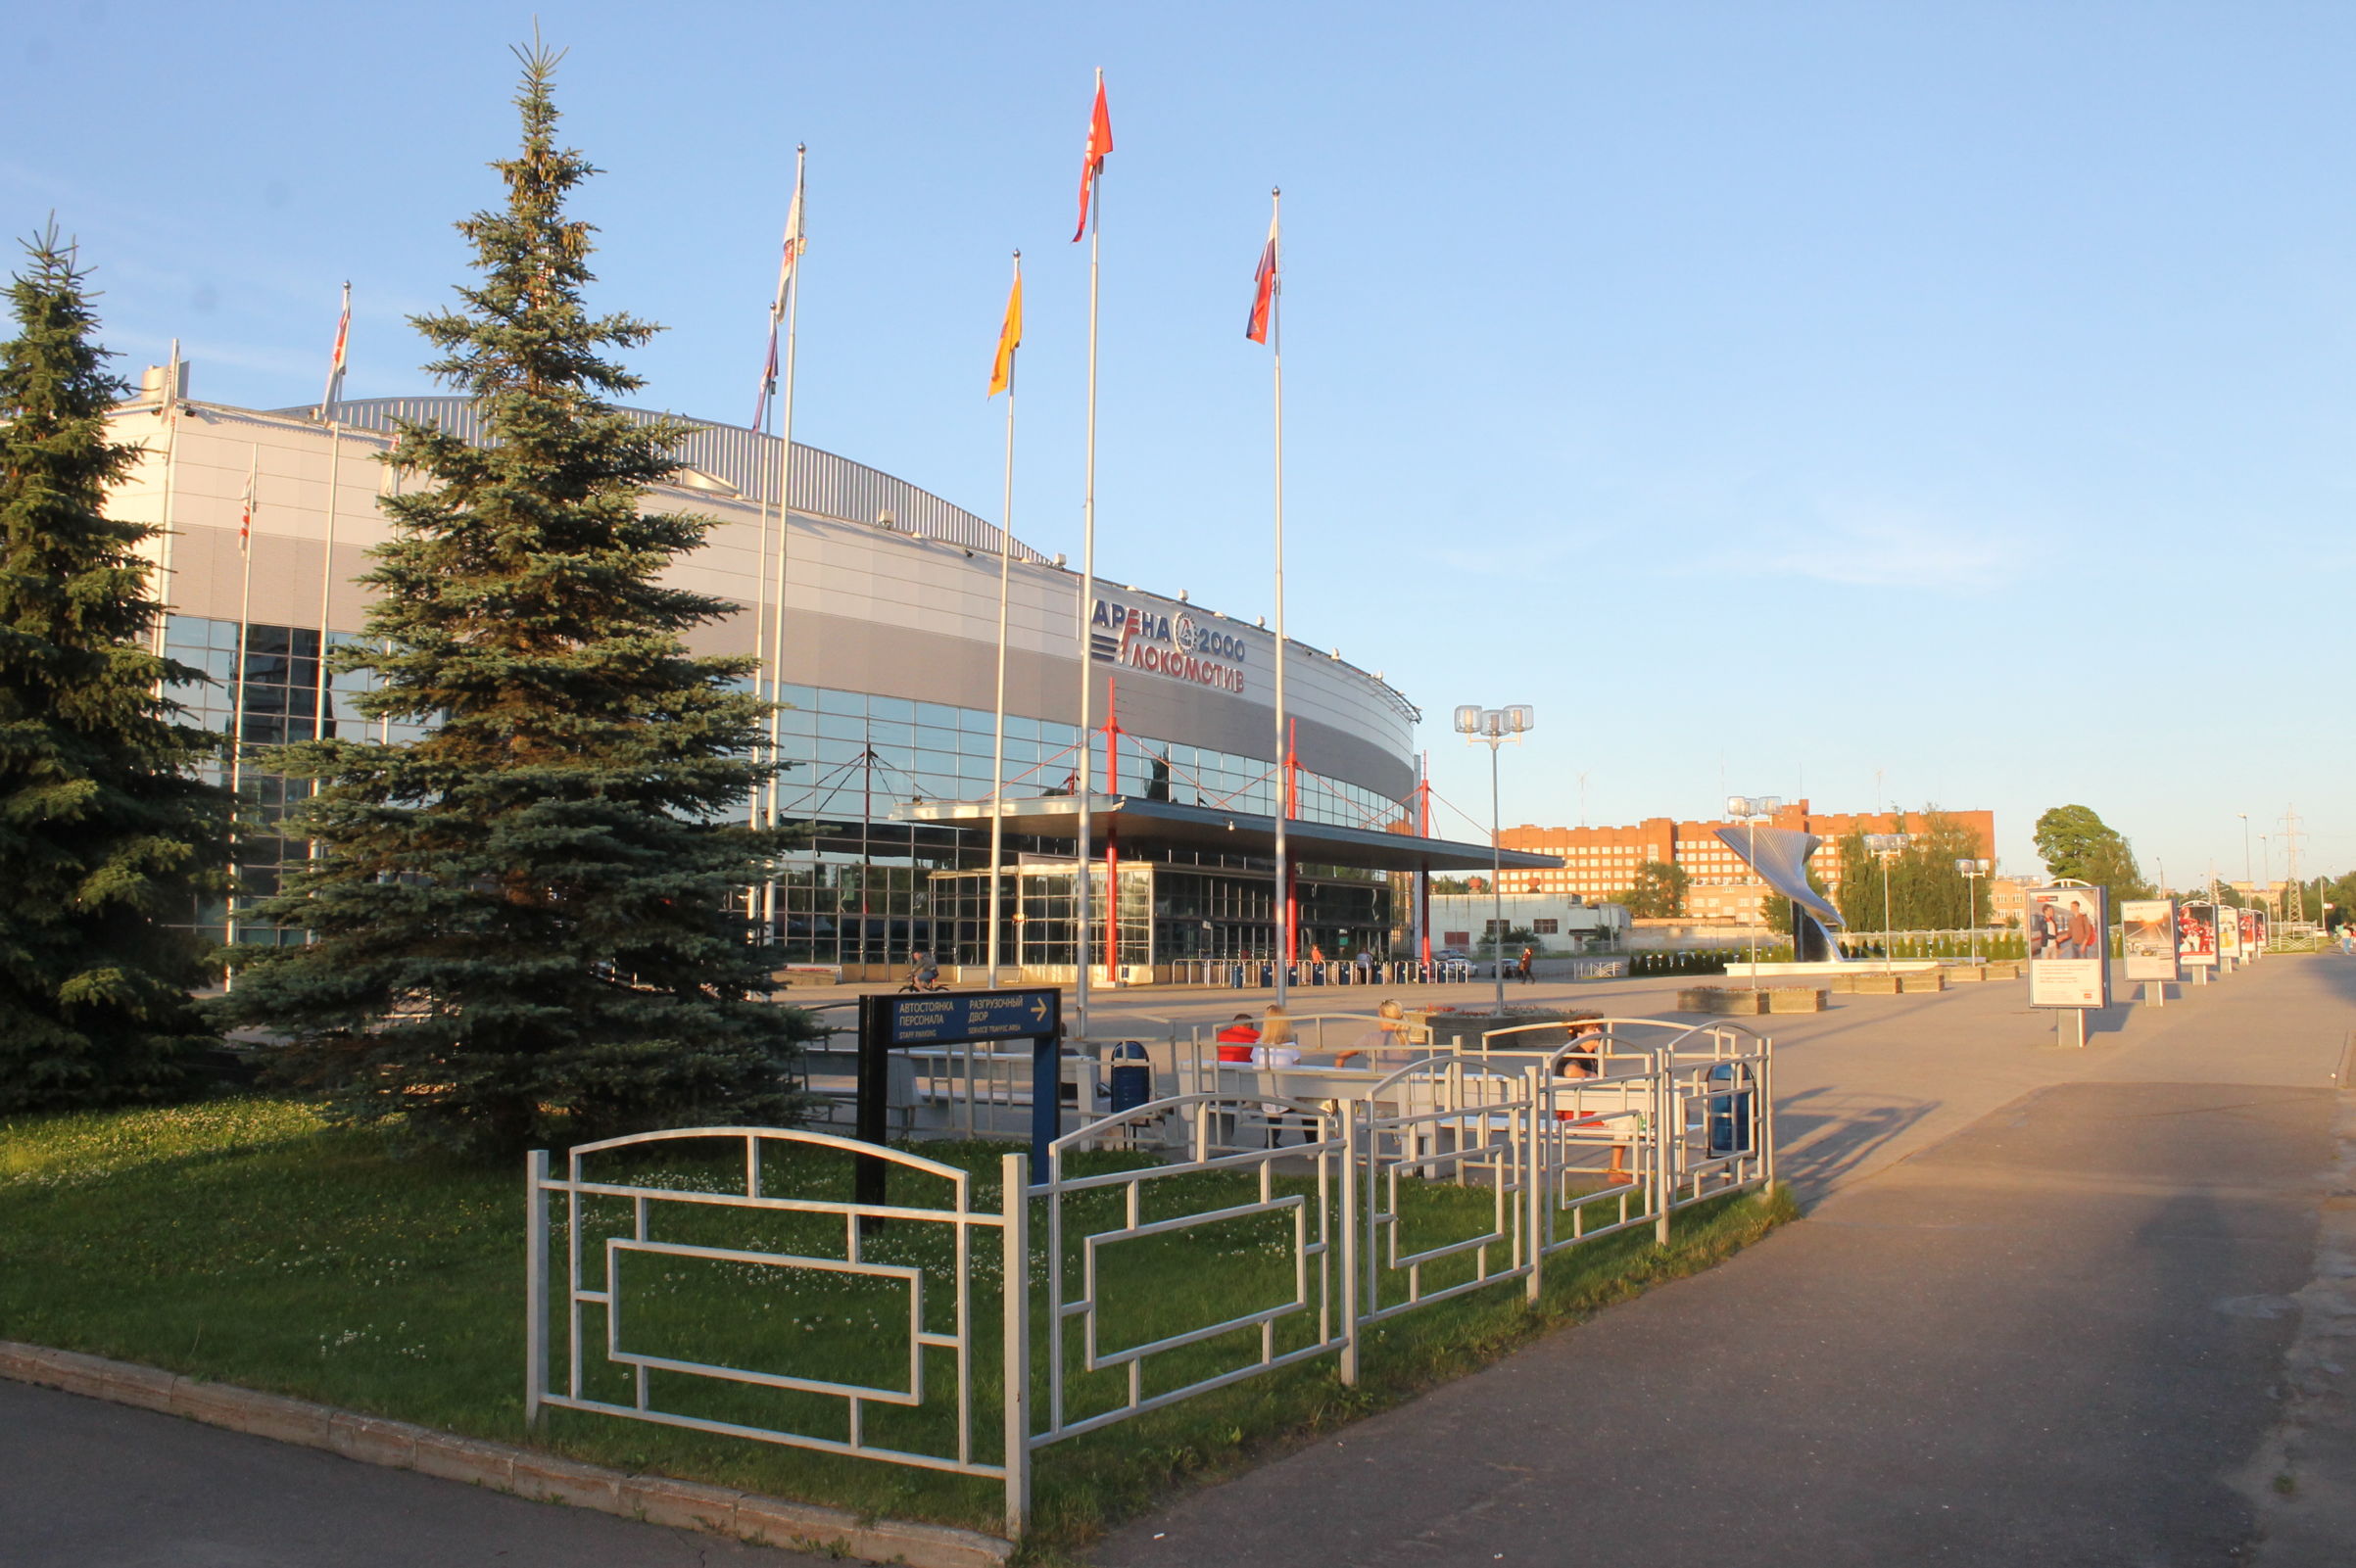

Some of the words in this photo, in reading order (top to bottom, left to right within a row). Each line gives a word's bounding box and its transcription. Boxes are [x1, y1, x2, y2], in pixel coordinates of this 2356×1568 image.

[1091, 599, 1172, 662] АРЕНА
[1197, 628, 1245, 662] 2000
[1130, 643, 1244, 693] ЛОКОМОТИВ
[899, 1001, 953, 1013] АВТОСТОЯНКА
[969, 996, 1023, 1009] РАЗГРУЗОЧНЫЙ
[899, 1014, 944, 1026] ПЕРСОНАЛА
[968, 1012, 988, 1024] ДВОР
